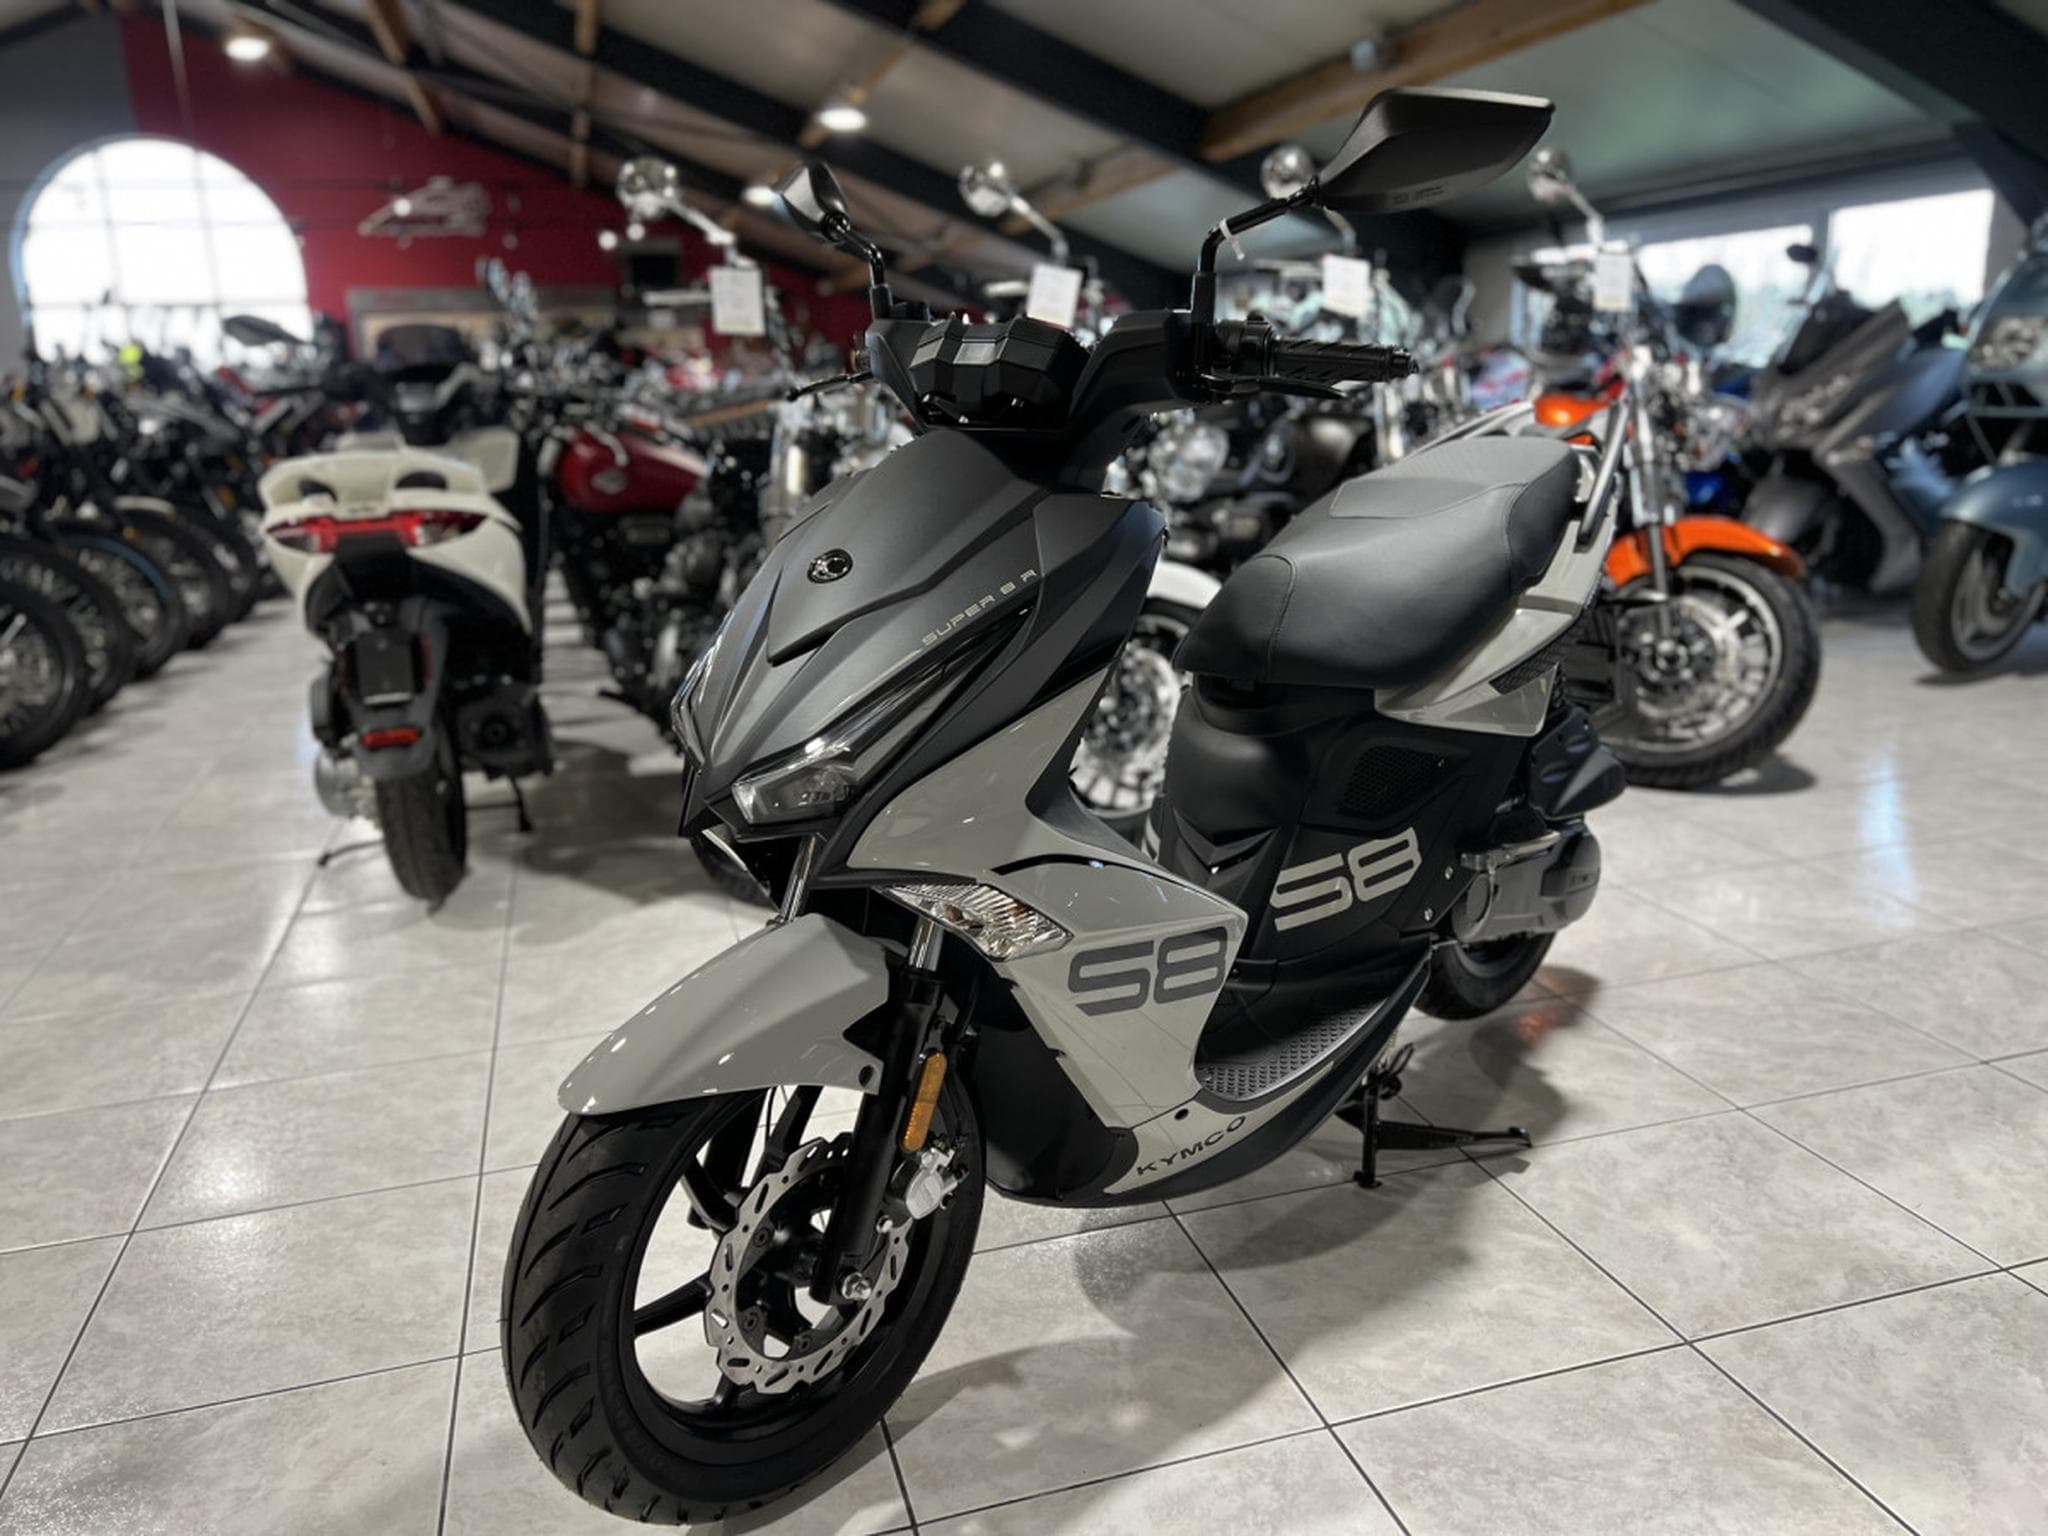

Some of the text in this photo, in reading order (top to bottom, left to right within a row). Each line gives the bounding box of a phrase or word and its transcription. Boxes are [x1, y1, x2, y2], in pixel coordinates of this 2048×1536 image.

[922, 569, 1037, 646] SUPER 8 R
[1270, 826, 1423, 932] S8
[1068, 926, 1228, 1017] S8
[1136, 1116, 1246, 1176] KYMCO
